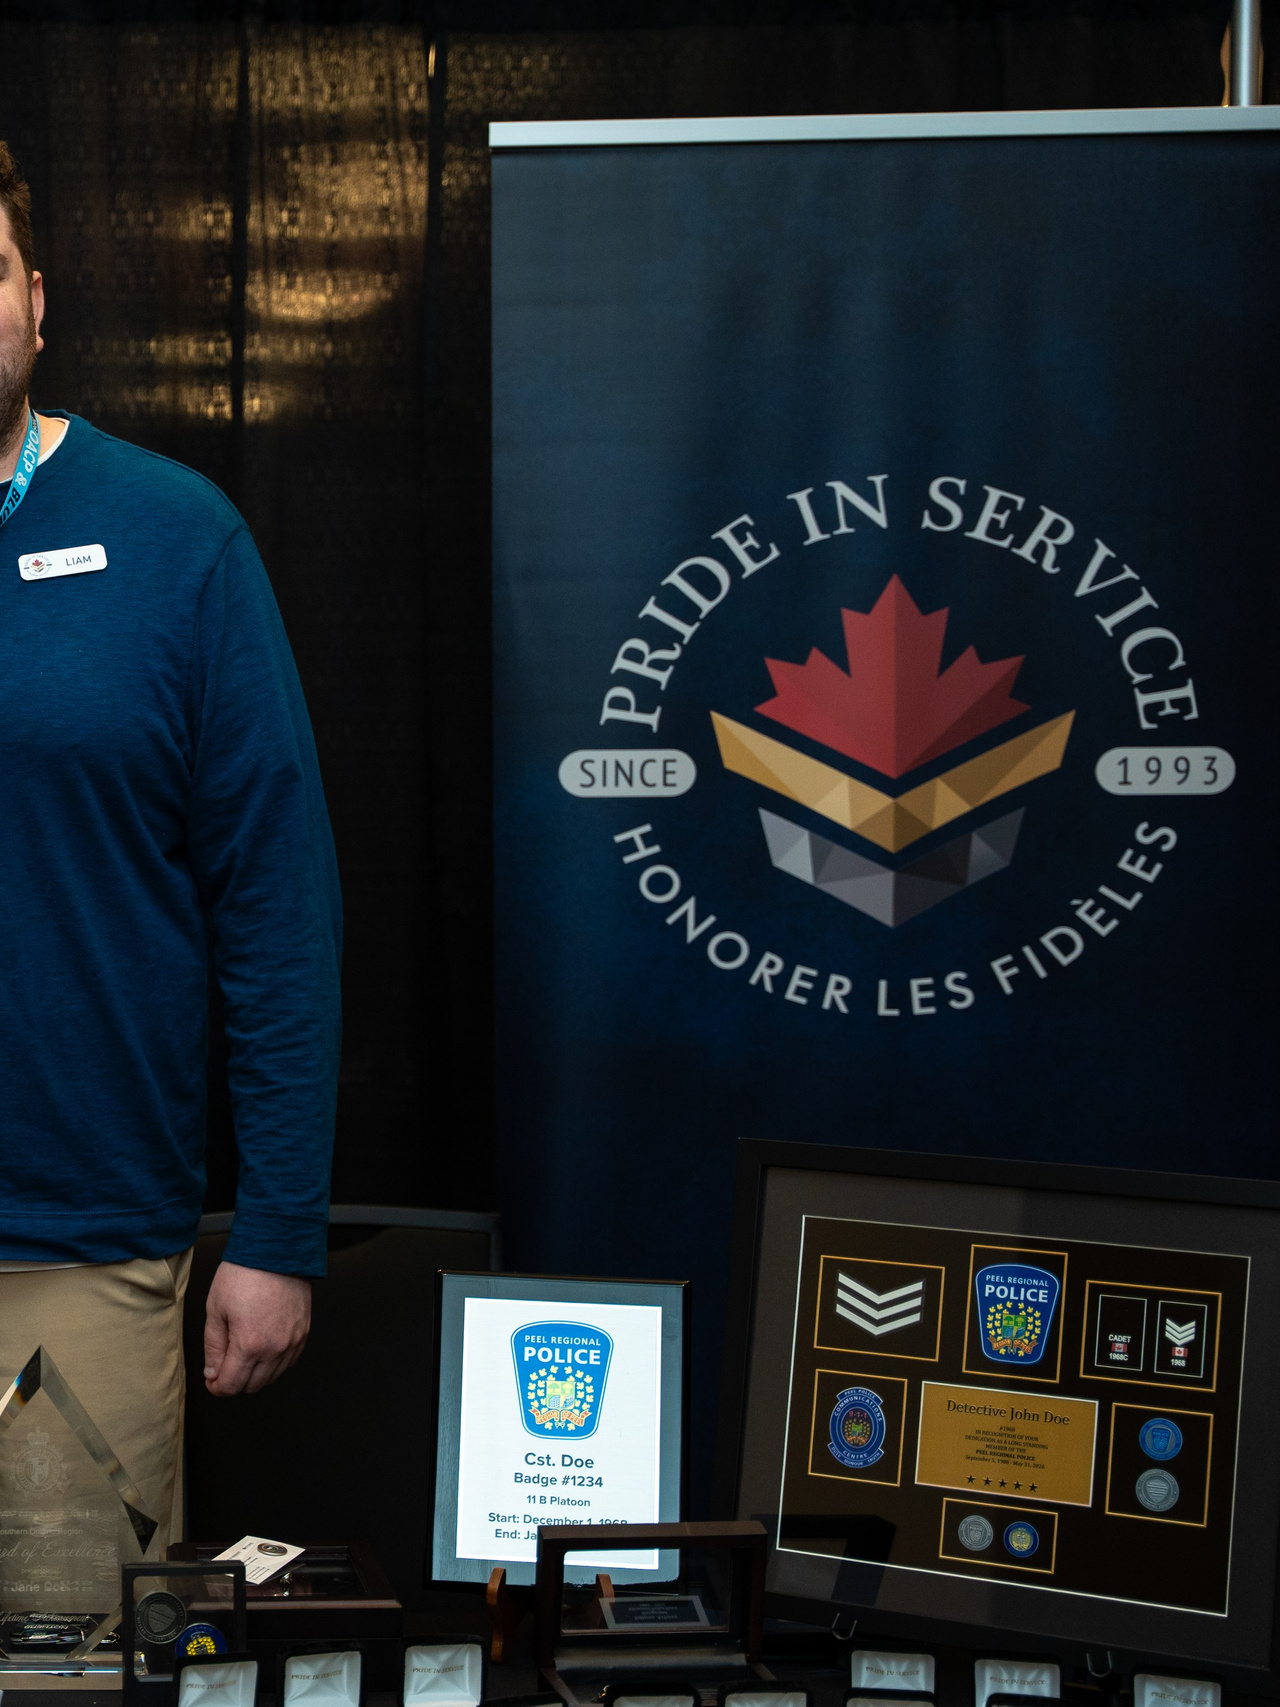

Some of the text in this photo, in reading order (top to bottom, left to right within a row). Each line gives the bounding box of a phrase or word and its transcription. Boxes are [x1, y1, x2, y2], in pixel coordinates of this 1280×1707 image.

[23, 429, 39, 472] OACP
[15, 472, 27, 487] &
[66, 555, 91, 566] LIAM
[600, 473, 1199, 733] PRIDE IN SERVICE
[579, 758, 679, 788] SINCE
[1116, 755, 1219, 787] 1993
[613, 821, 1179, 1017] HONORER LES FIDÈLES
[986, 1274, 1049, 1288] PEEL REGIONAL
[985, 1283, 1049, 1303] POLICE
[524, 1335, 601, 1346] PEEL REGIONAL
[1108, 1334, 1131, 1343] CADET
[524, 1346, 601, 1365] POLICE
[1109, 1353, 1129, 1361] 1968C
[1170, 1358, 1186, 1367] 1968
[834, 1396, 882, 1422] COMMUNICATIONS
[947, 1399, 1070, 1425] Detective John Doe
[982, 1430, 1017, 1439] RECOGNITION
[524, 1452, 594, 1469] Cst. Doe
[843, 1450, 868, 1459] CENTRE
[989, 1450, 1016, 1459] REGIONAL
[513, 1472, 604, 1490] Badge #1234
[527, 1495, 590, 1507] 11 B Platoon
[488, 1513, 583, 1525] Start: December
[495, 1529, 521, 1539] End:
[22, 1541, 41, 1563] of
[441, 1664, 465, 1673] SERVICE
